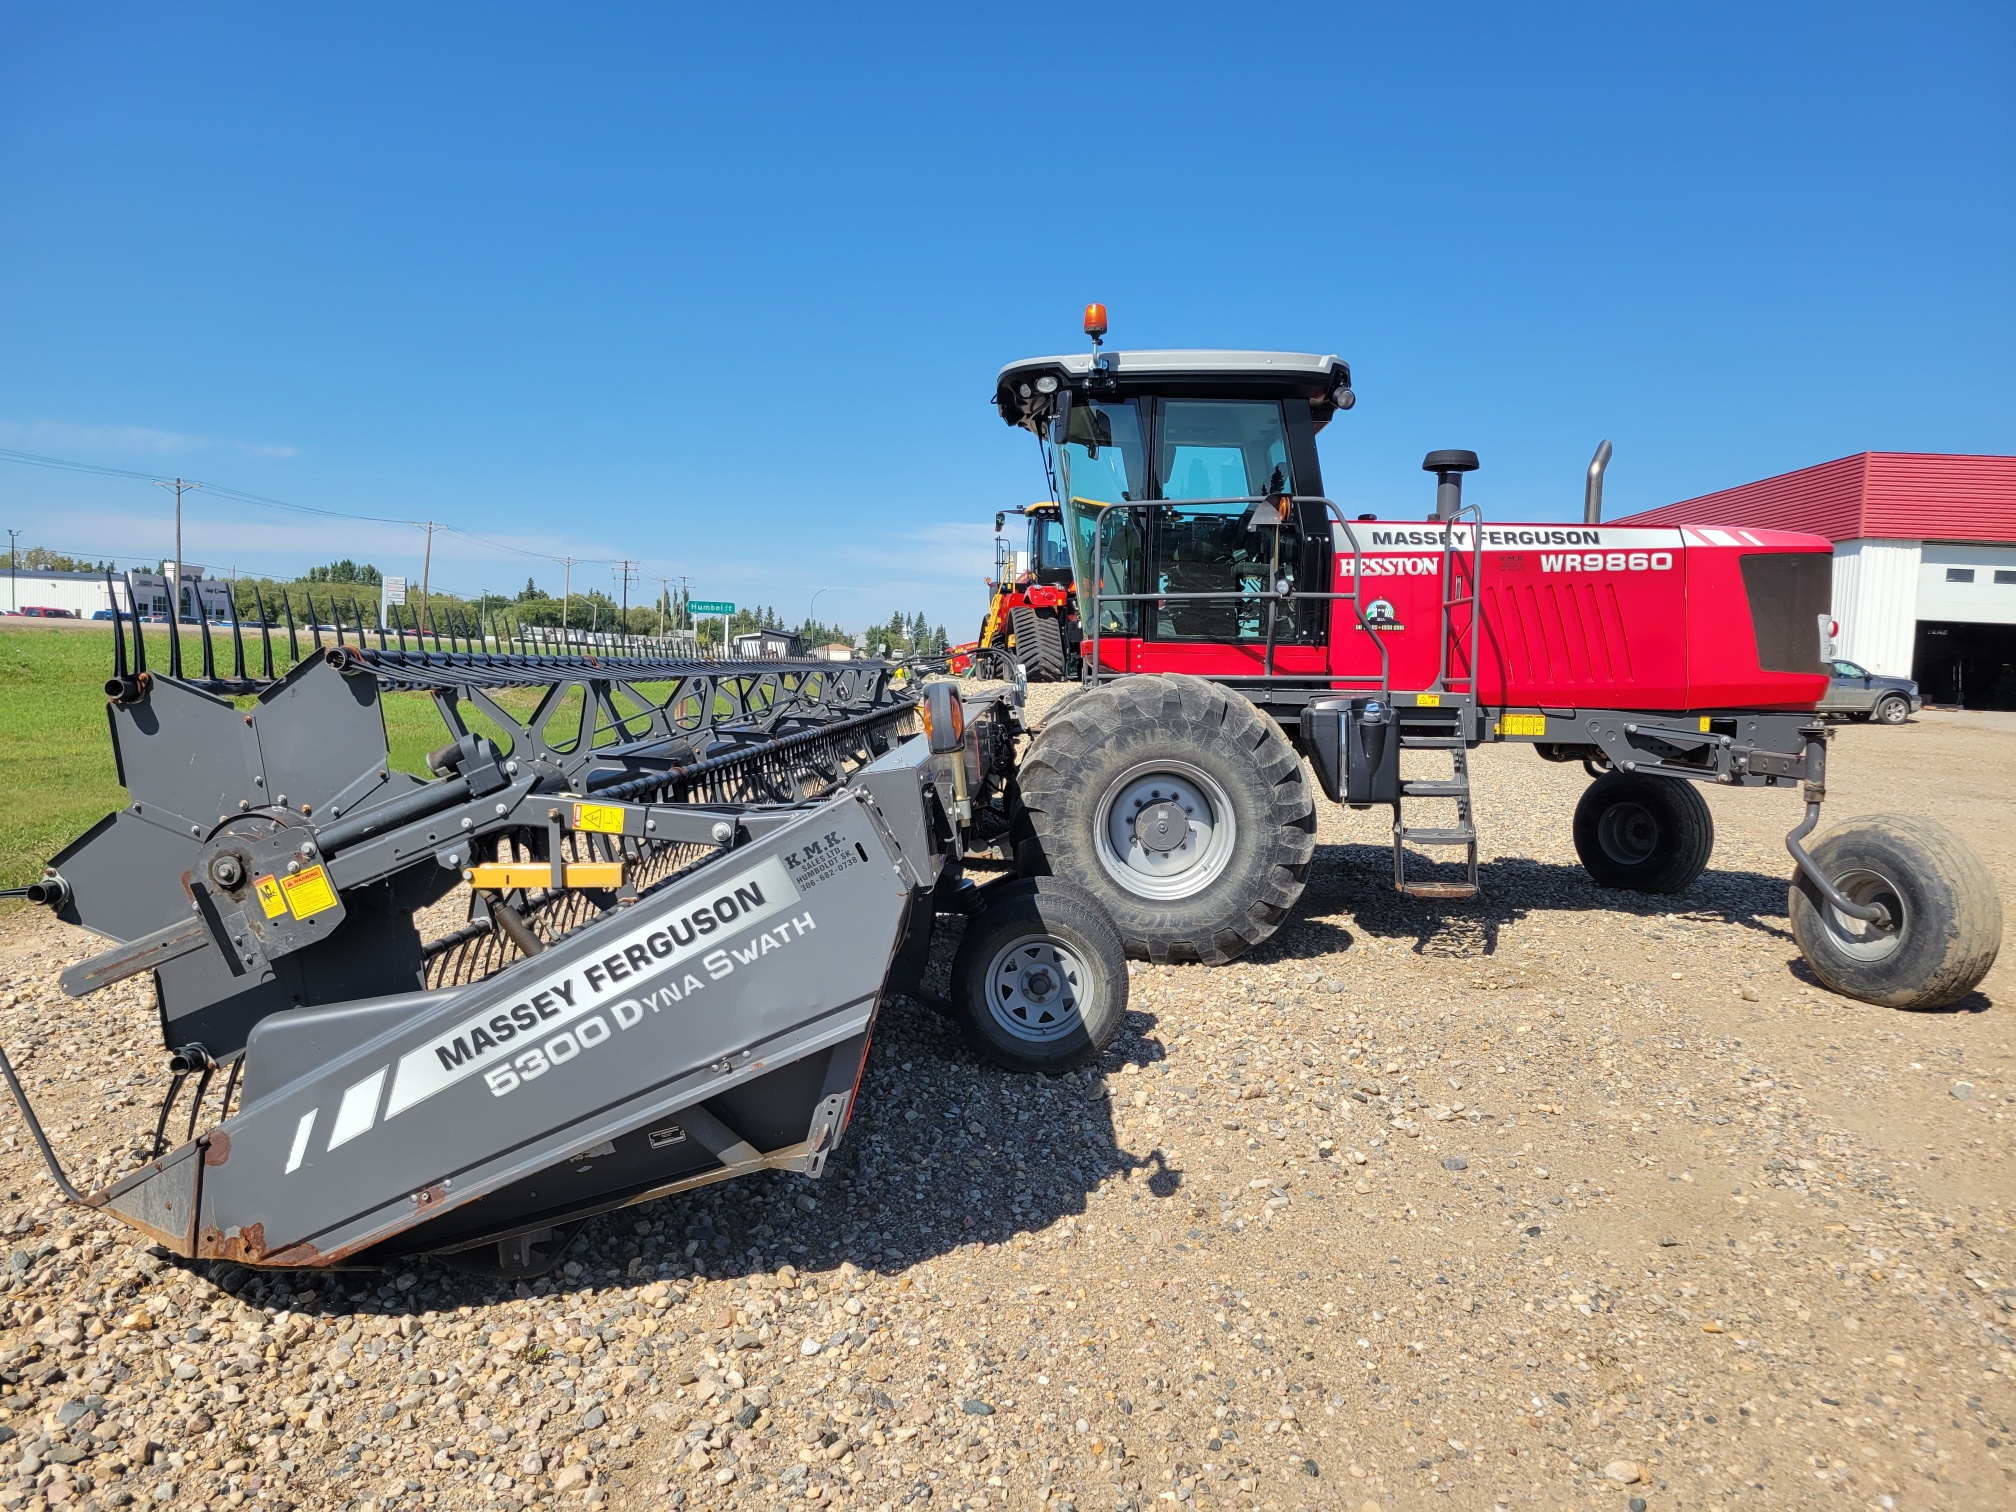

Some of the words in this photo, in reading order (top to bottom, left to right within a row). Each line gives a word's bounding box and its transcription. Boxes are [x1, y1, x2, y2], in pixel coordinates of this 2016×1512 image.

[1372, 531, 1467, 545] MASSEY
[1339, 557, 1439, 577] HESSTON
[1540, 552, 1673, 573] WR9860
[691, 603, 732, 611] Humboldt
[785, 831, 846, 869] K.M.K.
[801, 855, 826, 872] SALES
[826, 847, 844, 859] LTD.
[293, 871, 319, 884] WARNING
[795, 856, 839, 884] HUMBOLDT
[840, 849, 854, 860] SK.
[800, 856, 858, 892] 306-682-0738
[435, 979, 577, 1072] MASSEY
[583, 881, 767, 993] FERGUSON
[483, 1015, 611, 1097] 5300
